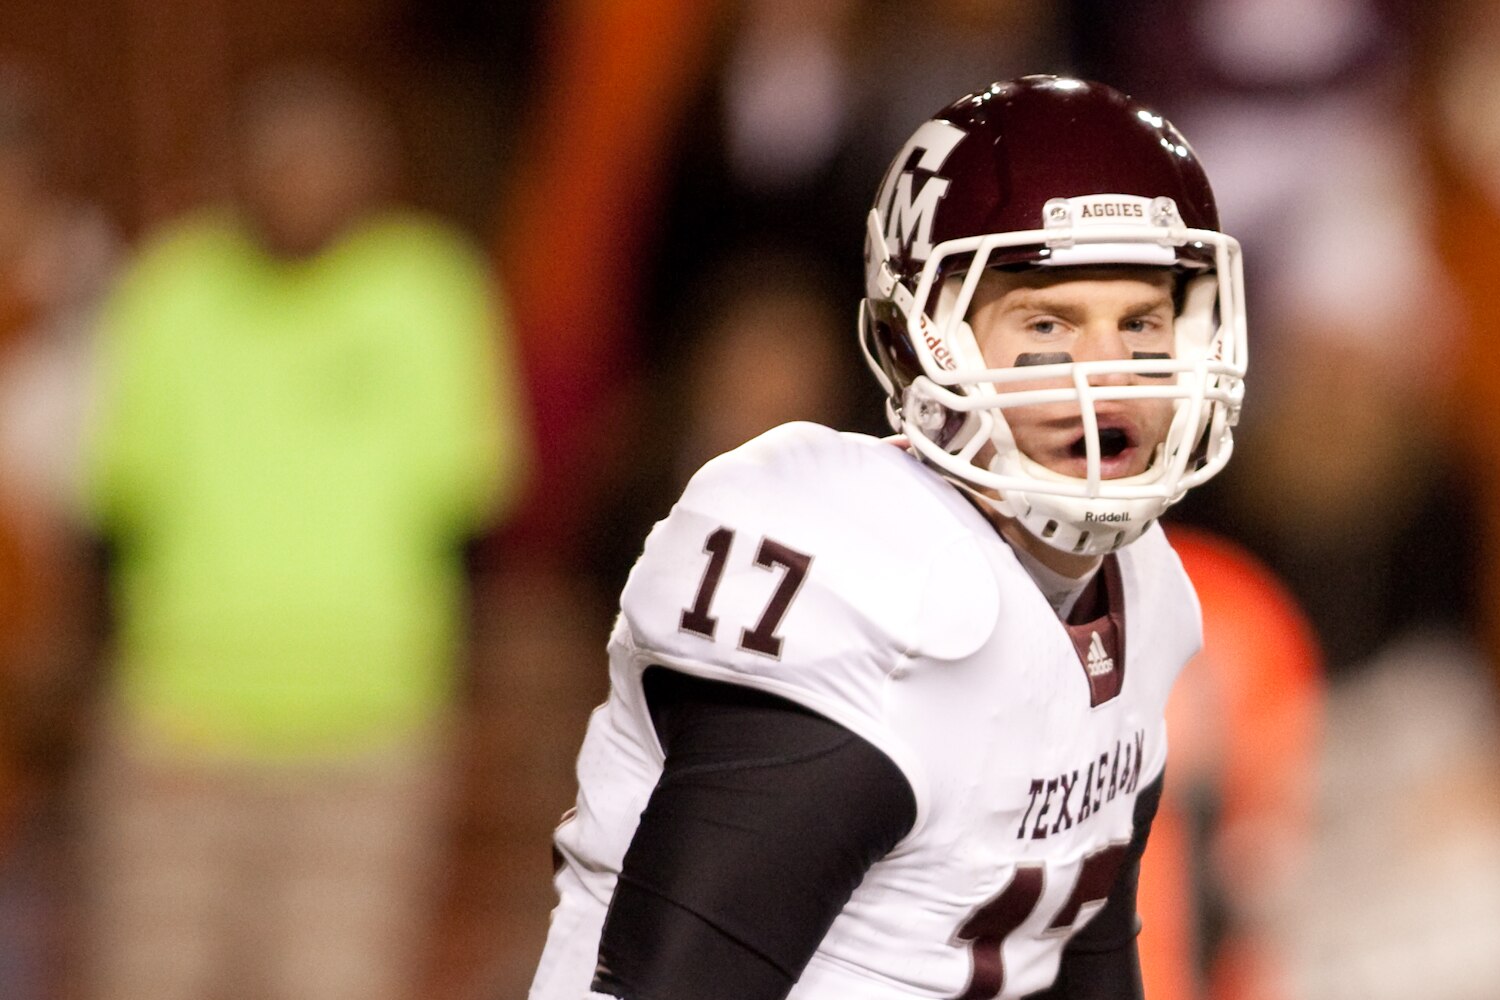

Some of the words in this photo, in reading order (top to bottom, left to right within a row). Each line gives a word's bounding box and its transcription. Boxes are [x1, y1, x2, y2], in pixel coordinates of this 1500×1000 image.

[1081, 203, 1143, 218] AGGIES
[678, 527, 815, 660] 17
[1016, 751, 1109, 840] TEXAS
